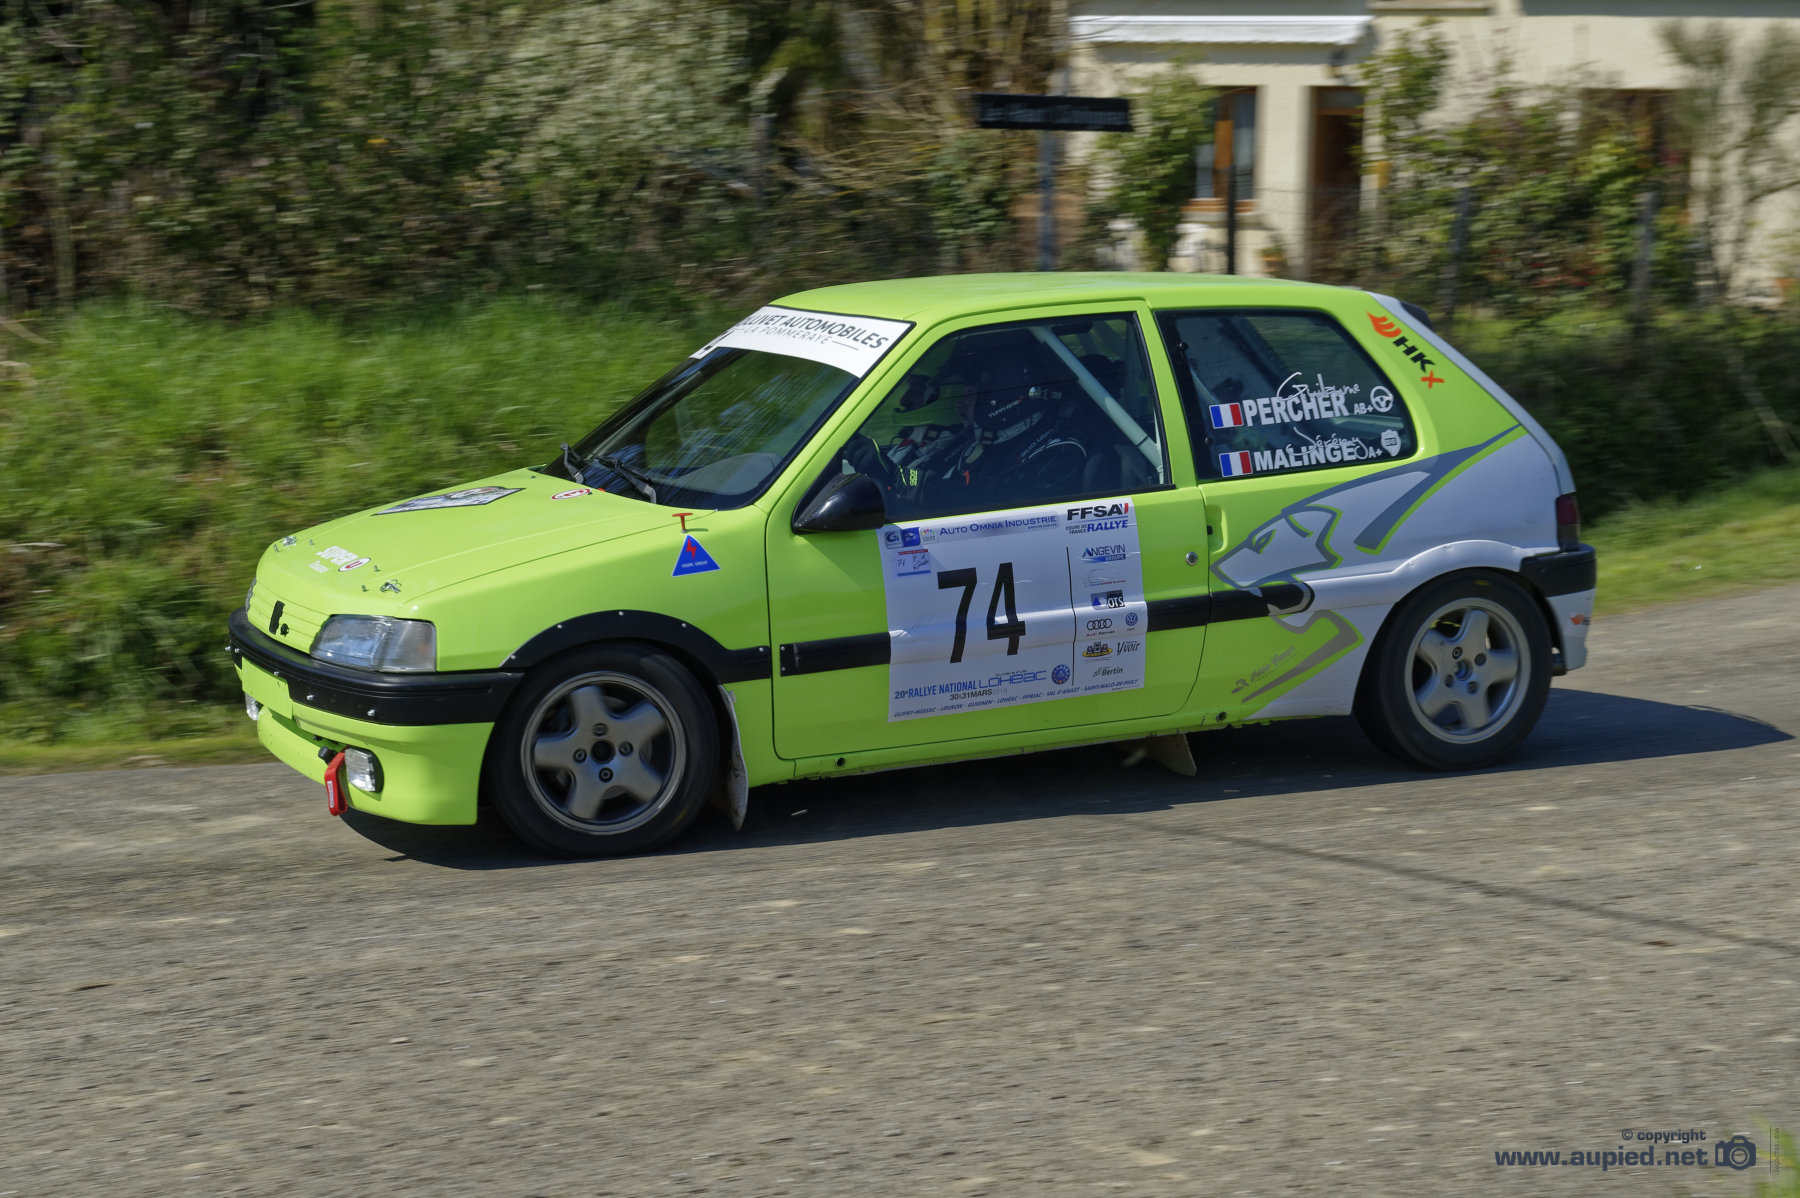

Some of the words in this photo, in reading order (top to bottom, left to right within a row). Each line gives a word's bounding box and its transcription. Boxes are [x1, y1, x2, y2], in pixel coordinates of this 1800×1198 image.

[783, 316, 888, 349] AUTOMOBILES
[1243, 394, 1350, 426] PERCHER
[1067, 503, 1122, 520] FFSA
[970, 523, 1002, 533] OMNIA
[1005, 515, 1056, 528] INDUSTRIE
[1087, 520, 1128, 532] RALLYE
[1082, 544, 1126, 558] ANGEVIN
[1108, 596, 1125, 609] OTS
[937, 562, 1026, 664] 74
[908, 685, 936, 698] RALLYE
[938, 680, 978, 695] NATIONAL
[970, 688, 993, 699] MARS
